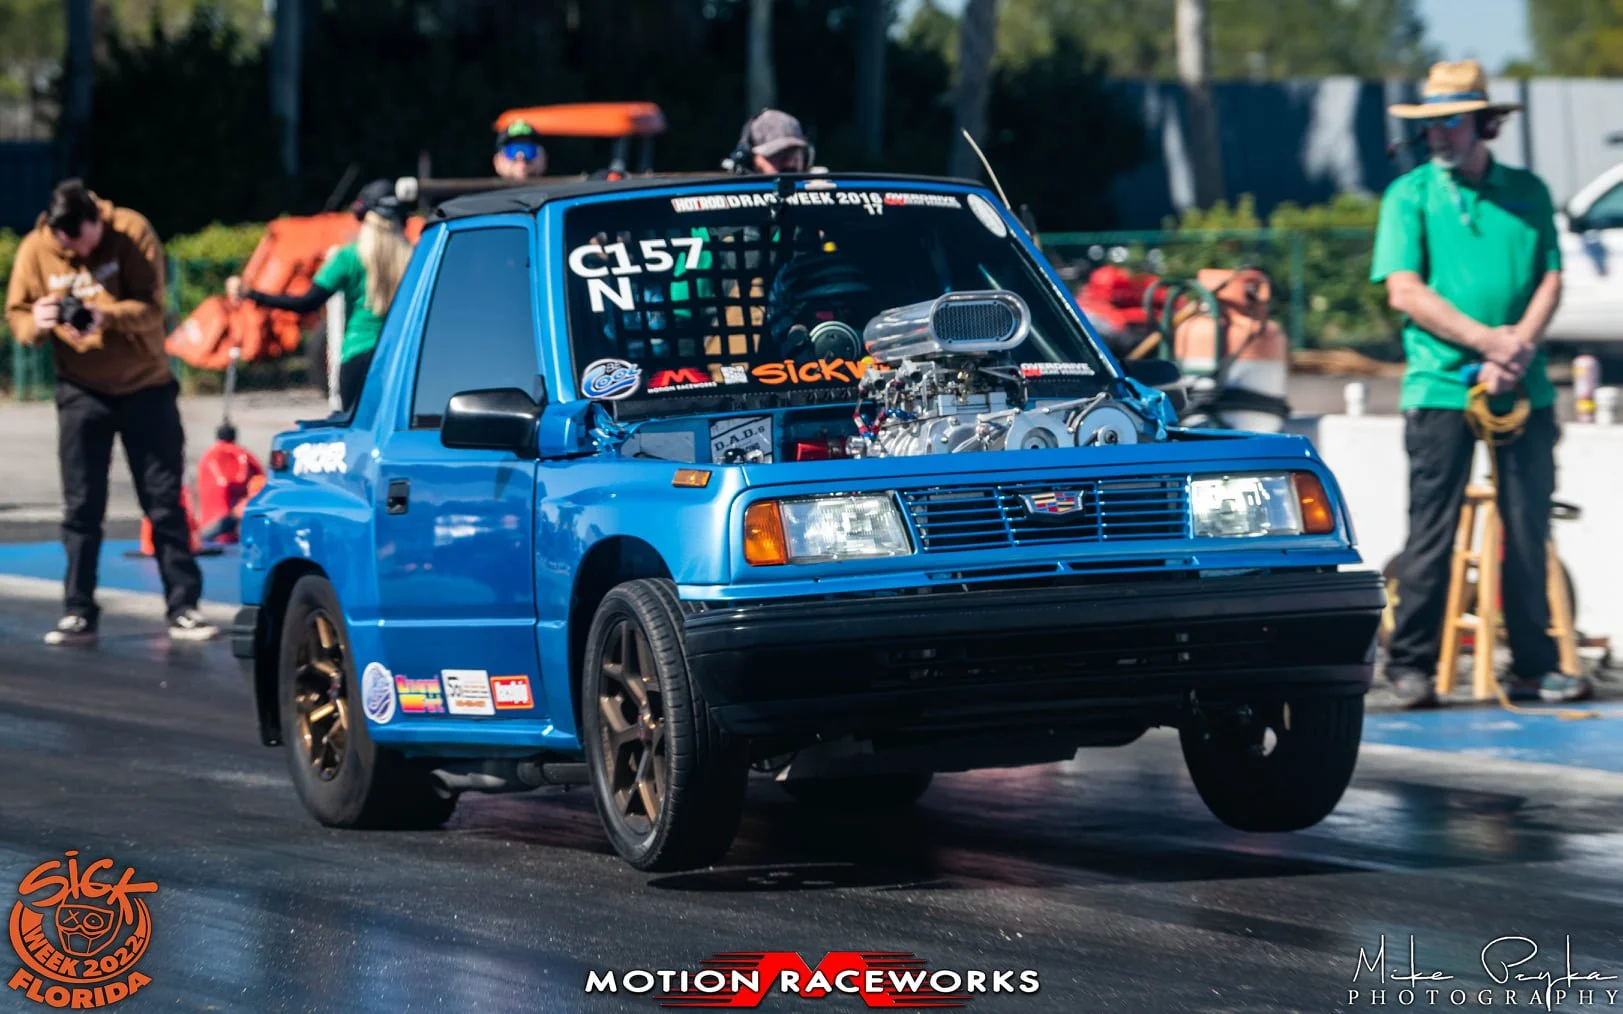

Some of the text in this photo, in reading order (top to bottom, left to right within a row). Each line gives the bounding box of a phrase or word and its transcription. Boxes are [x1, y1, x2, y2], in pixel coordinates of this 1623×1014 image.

[785, 192, 835, 205] WEEK
[863, 203, 883, 215] 17
[568, 237, 703, 278] C157
[587, 276, 635, 313] N
